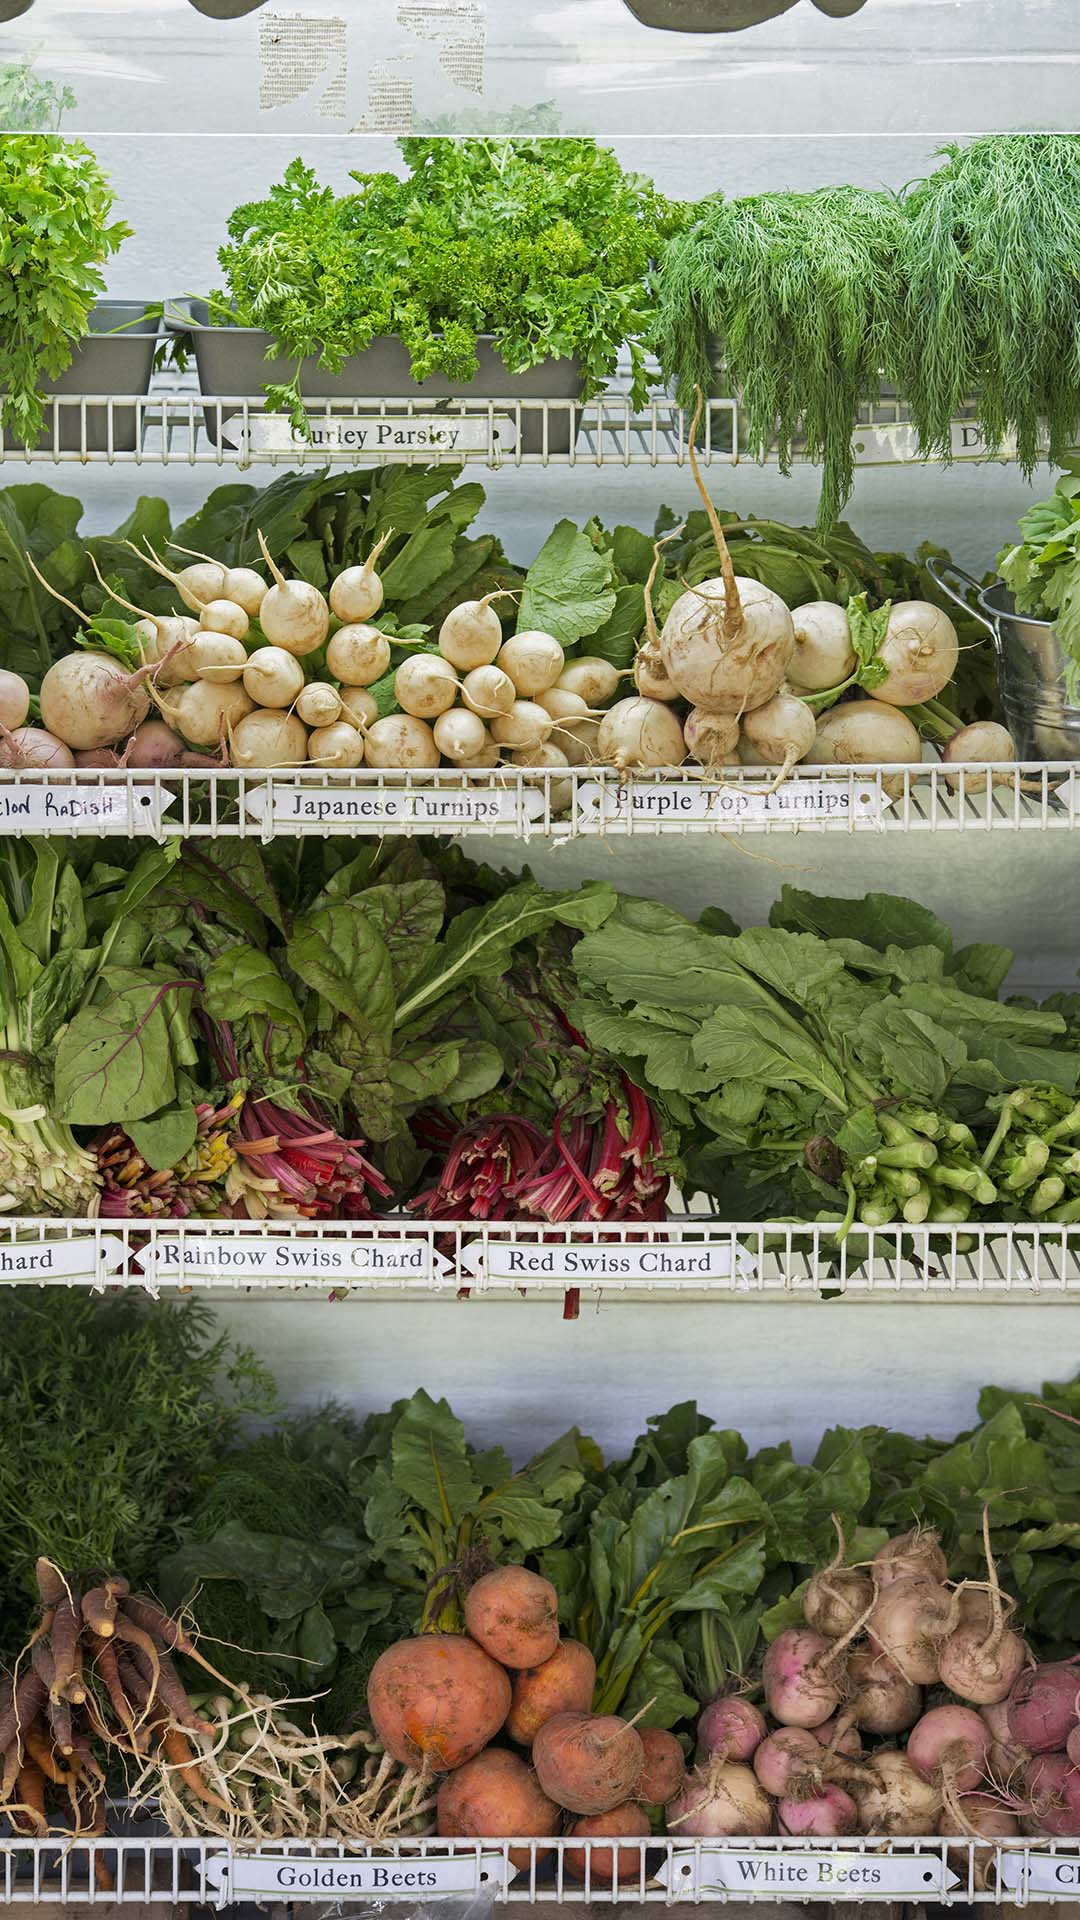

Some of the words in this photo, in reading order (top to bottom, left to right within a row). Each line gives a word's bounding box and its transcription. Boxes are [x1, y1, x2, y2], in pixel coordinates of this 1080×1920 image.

[291, 424, 368, 449] Curley
[376, 424, 460, 449] Parsley
[292, 795, 397, 820] Japanese
[404, 796, 500, 821] Turnips
[613, 789, 692, 815] Purple
[701, 790, 749, 815] Top
[762, 790, 849, 814] Turnips
[163, 1244, 268, 1265] Rainbow
[275, 1246, 342, 1267] Swiss
[351, 1247, 423, 1268] Chard
[508, 1251, 554, 1271] Red
[564, 1252, 630, 1272] Swiss
[639, 1252, 712, 1272] Chard
[277, 1866, 362, 1887] Golden
[372, 1867, 437, 1887] Beets
[737, 1860, 808, 1882] White
[817, 1862, 881, 1883] Beets
